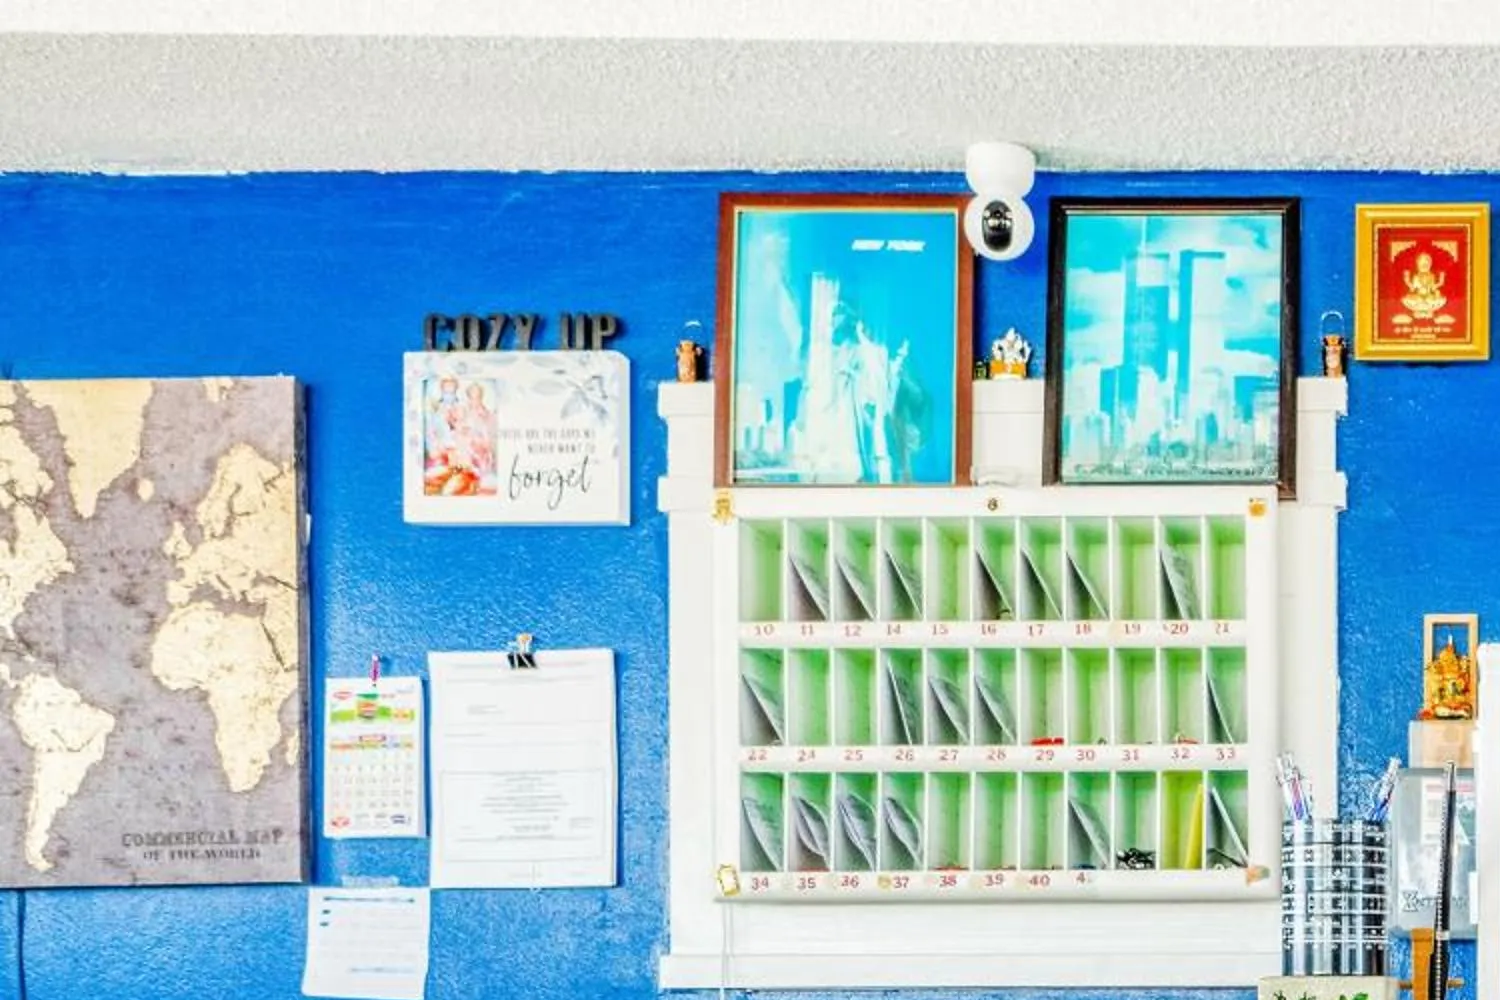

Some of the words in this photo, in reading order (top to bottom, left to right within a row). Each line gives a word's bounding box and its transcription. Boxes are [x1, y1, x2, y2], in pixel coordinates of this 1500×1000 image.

[424, 314, 540, 352] COZY
[560, 314, 617, 351] UP
[508, 453, 591, 511] forget
[755, 625, 775, 636] 10
[800, 624, 815, 636] 11
[844, 626, 862, 637] 12
[886, 624, 901, 635] 14
[931, 624, 949, 635] 15
[981, 624, 997, 635] 16
[1028, 624, 1044, 636] 17
[1074, 623, 1091, 634] 18
[1123, 623, 1141, 634] 19
[1170, 623, 1189, 634] 20
[748, 750, 767, 761] 22
[844, 750, 863, 761] 25
[895, 750, 914, 762] 26
[939, 750, 959, 761] 27
[988, 750, 1006, 761] 28
[1035, 749, 1054, 761] 29
[1077, 750, 1095, 761] 30
[1123, 749, 1140, 761] 31
[1171, 748, 1190, 760] 32
[1217, 748, 1236, 761] 33
[752, 878, 769, 891] 34
[799, 877, 817, 889] 35
[841, 876, 860, 888] 36
[894, 877, 910, 889] 37
[939, 876, 957, 887] 38
[985, 874, 1004, 887] 39
[1029, 874, 1050, 886] 40
